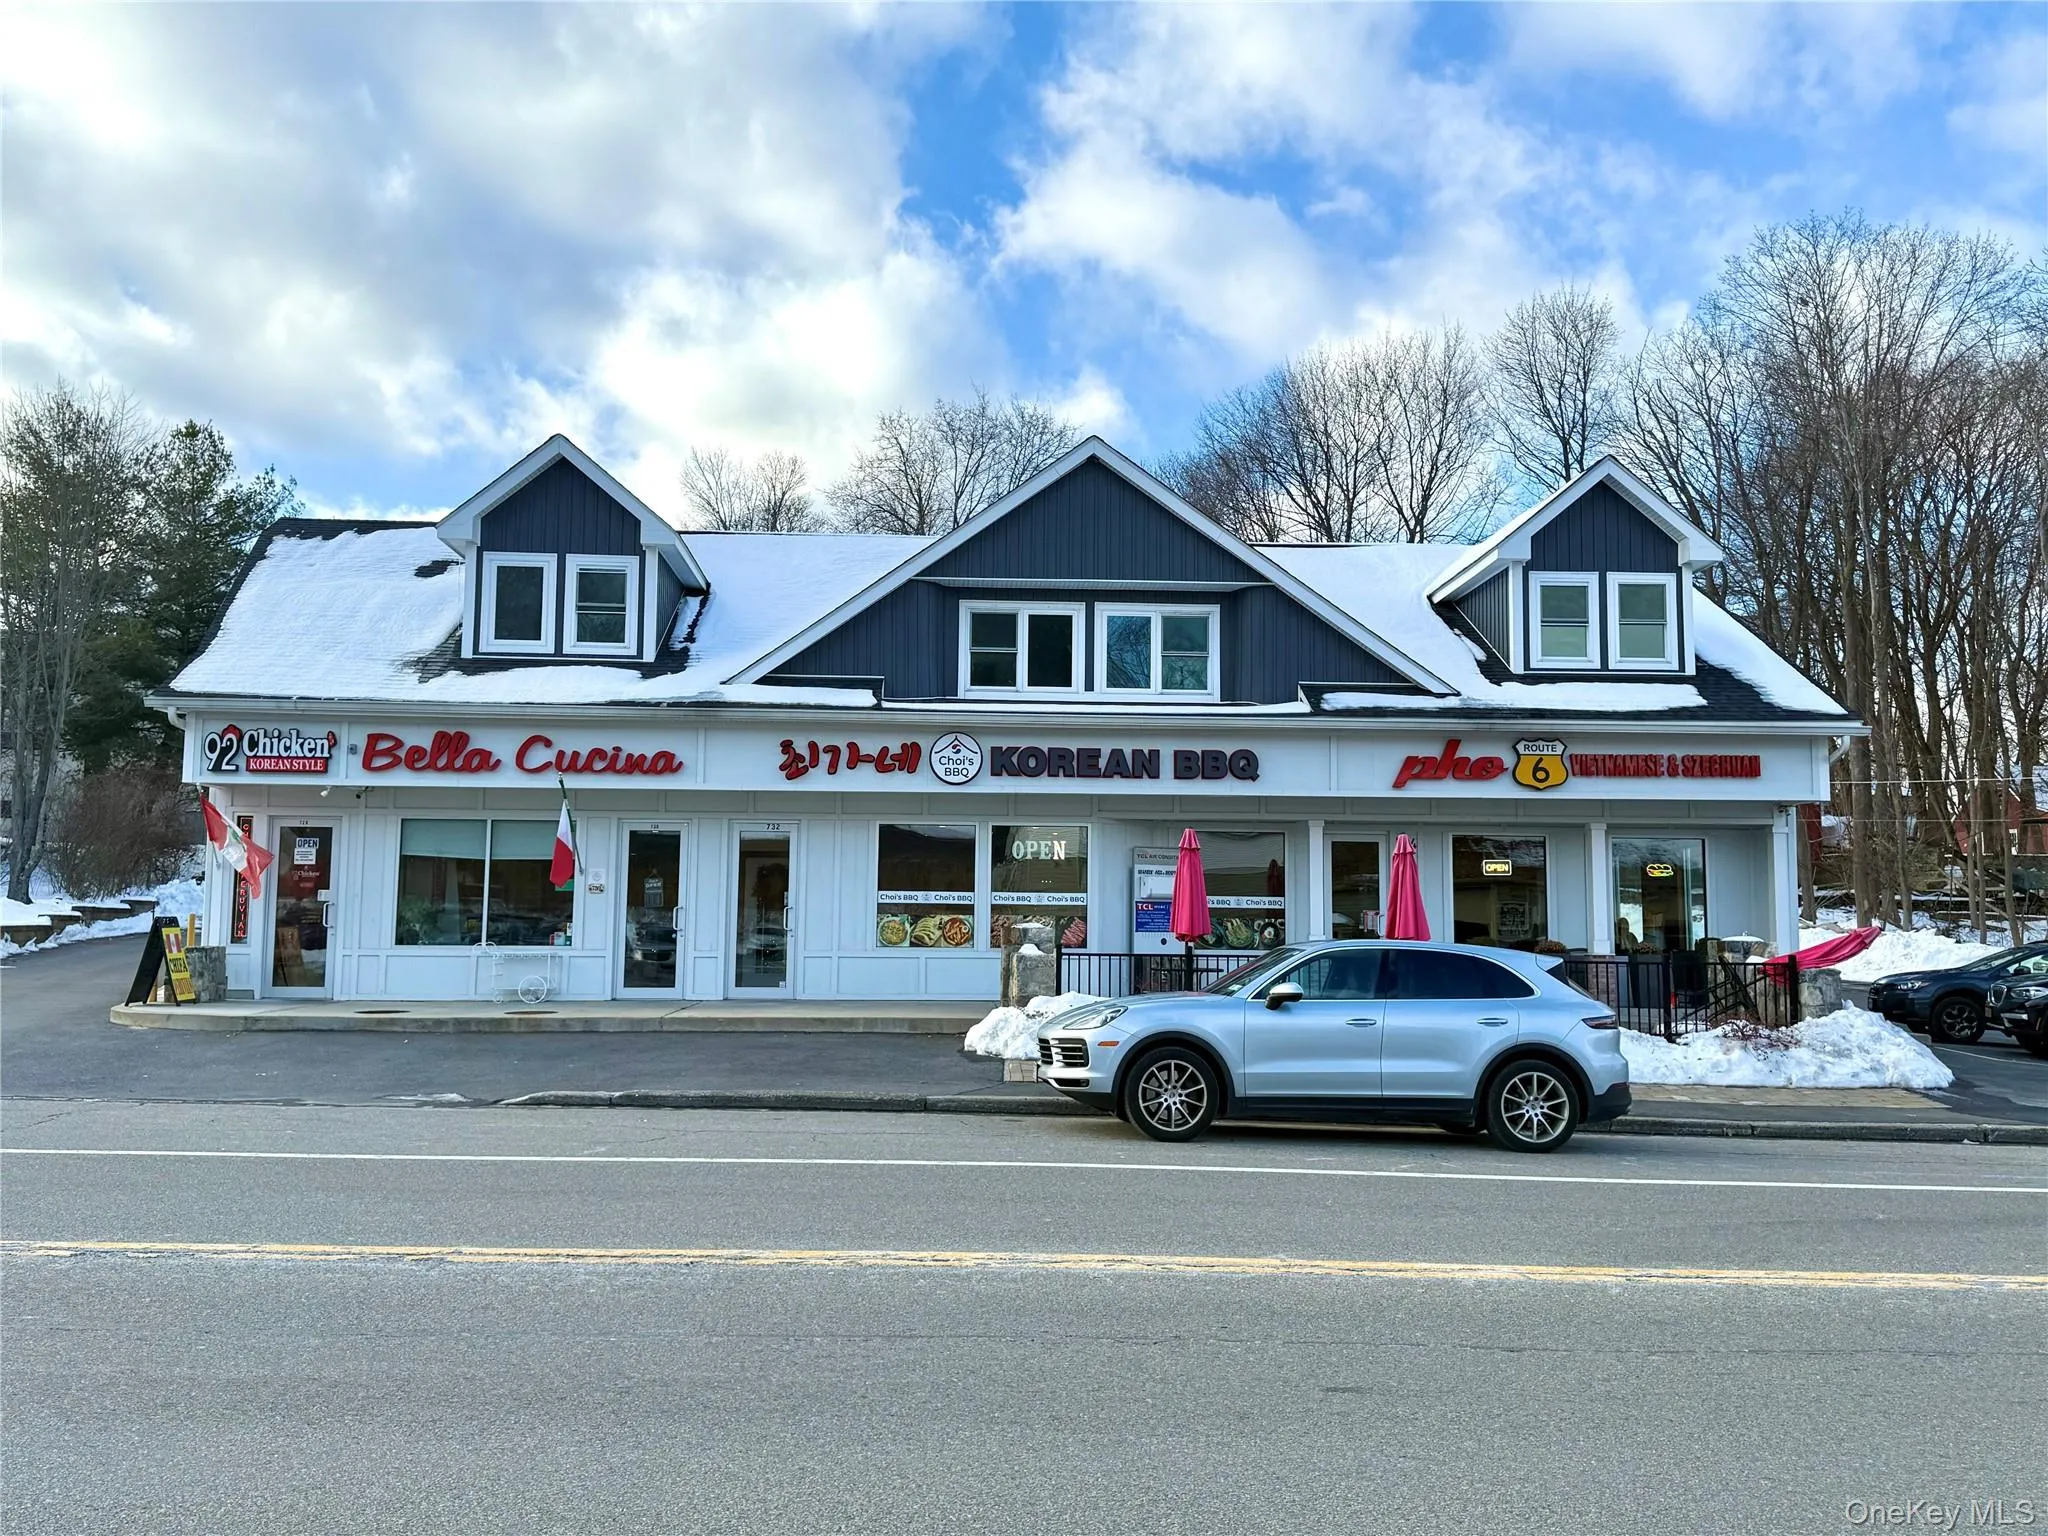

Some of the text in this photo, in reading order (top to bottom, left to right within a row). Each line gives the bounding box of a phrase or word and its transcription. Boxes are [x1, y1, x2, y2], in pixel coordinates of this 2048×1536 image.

[204, 732, 238, 771] 92
[361, 730, 684, 775] Bella Cucina
[1523, 744, 1557, 752] ROUTE
[249, 759, 324, 770] KOREAN STYLE
[779, 739, 922, 780] 최가네
[938, 755, 975, 766] Choi's
[990, 746, 1260, 783] KOREAN BBQ
[1392, 739, 1509, 788] pho
[1532, 757, 1550, 783] 6
[1569, 753, 1762, 778] VIETNAMESE & SZECHUAN
[944, 768, 970, 778] BBQ
[297, 838, 318, 848] OPEN
[1012, 840, 1067, 860] OPEN
[1485, 863, 1509, 872] OPEN
[880, 893, 902, 901] Choi's
[903, 894, 919, 902] BBQ
[934, 894, 956, 902] Choi's
[993, 894, 1015, 902] Choi's
[1016, 895, 1032, 903] BBQ
[1046, 895, 1069, 903] Choi's
[1069, 896, 1086, 904] BBQ
[1137, 903, 1154, 911] TCL
